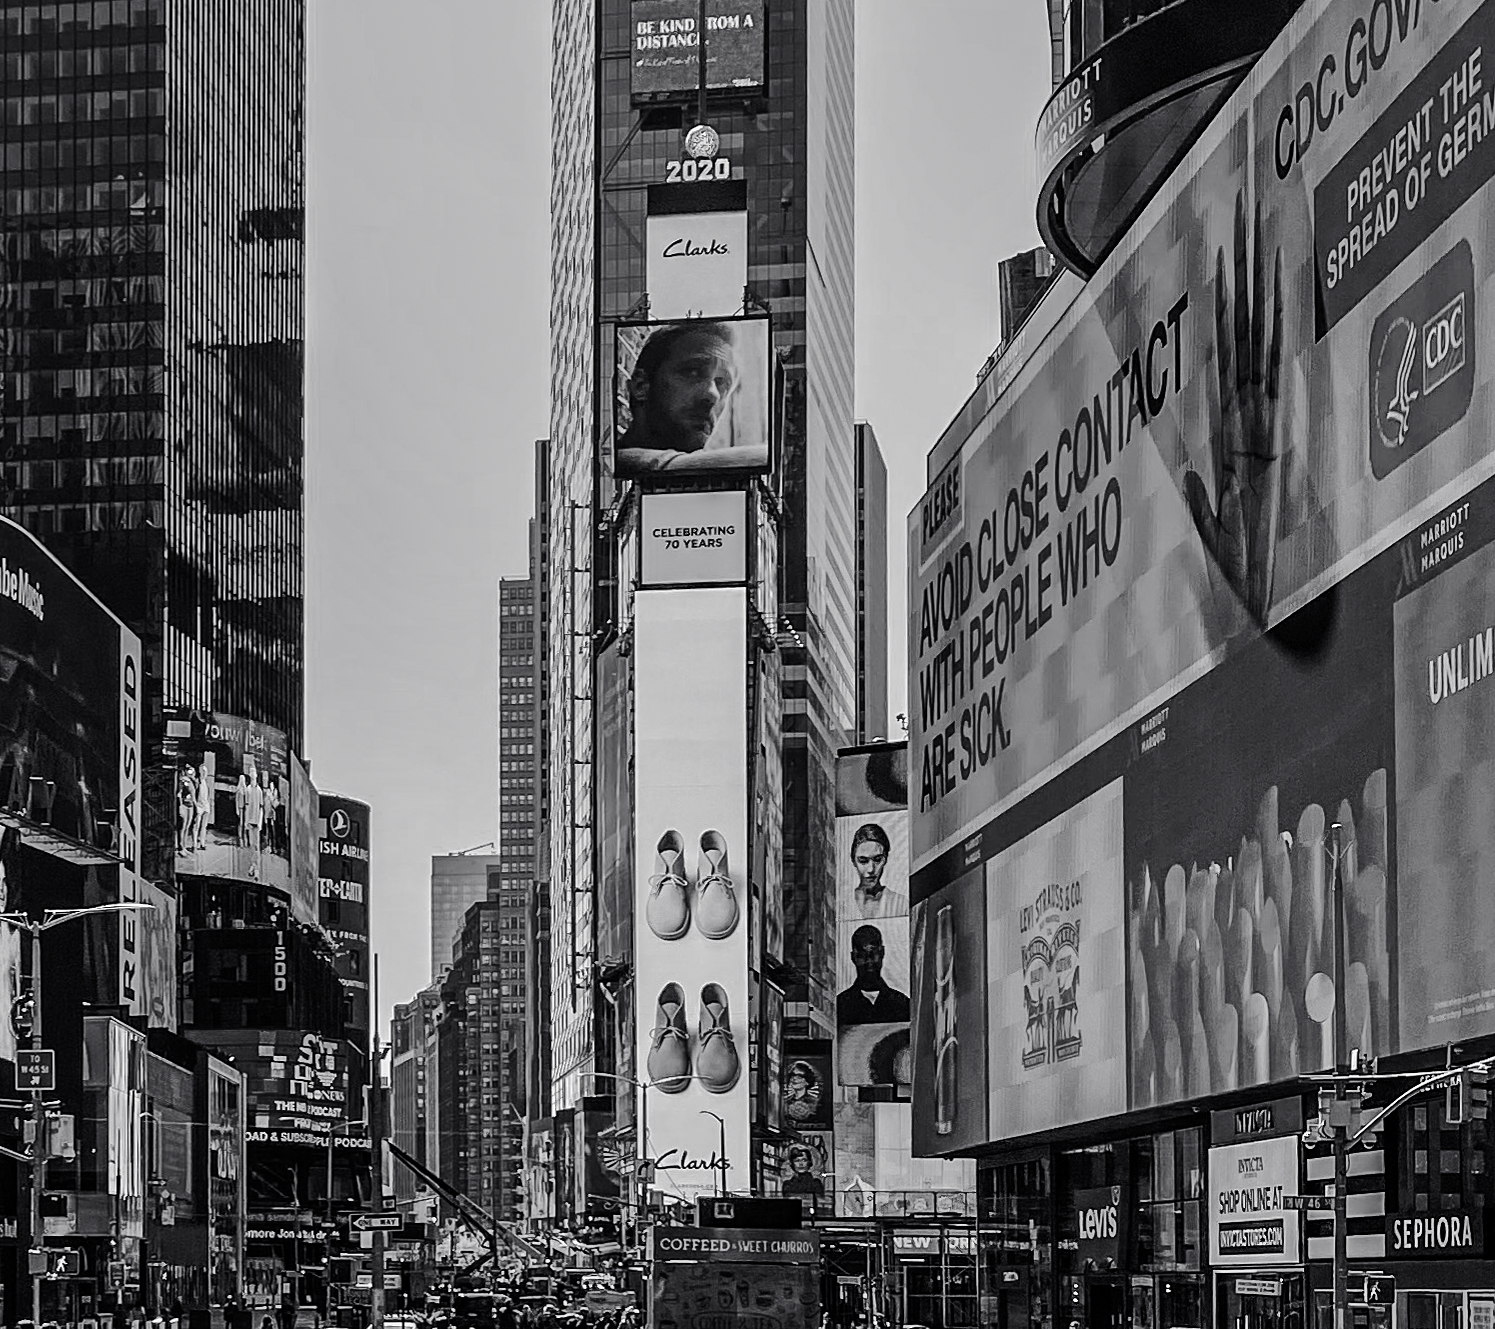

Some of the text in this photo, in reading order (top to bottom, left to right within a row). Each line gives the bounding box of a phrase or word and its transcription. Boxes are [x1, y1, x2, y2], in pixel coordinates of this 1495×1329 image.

[636, 14, 754, 35] BE KIND ROM A
[1347, 46, 1483, 224] PREVENT THE
[666, 157, 731, 184] 2020
[1326, 187, 1400, 290] SPREAD
[1404, 151, 1433, 212] OF
[662, 237, 729, 258] Clarks
[1425, 304, 1463, 370] CDC
[918, 291, 1190, 659] AVOID CLOSE CONTACT
[922, 465, 960, 546] PLEASE
[652, 525, 736, 538] CELEBRATING
[665, 538, 724, 550] 70 YEARS
[1419, 502, 1470, 550] MARRIOTT
[1420, 530, 1465, 573] MARQUIS
[918, 475, 1122, 734] WITH PEOPLE WHO
[1428, 626, 1495, 706] UNLIM
[919, 675, 1011, 815] ARE SICK.
[122, 653, 137, 1003] RELEASED
[274, 930, 287, 993] 1500
[30, 1054, 41, 1064] TO
[654, 1148, 732, 1171] Clarks
[1218, 1185, 1283, 1215] SHOP ONLINE AT
[1294, 1197, 1321, 1209] W 46
[660, 1237, 815, 1255] COFFEED SWEET CHURROS
[892, 1236, 931, 1249] NEW
[1393, 1215, 1473, 1250] SEPHORA
